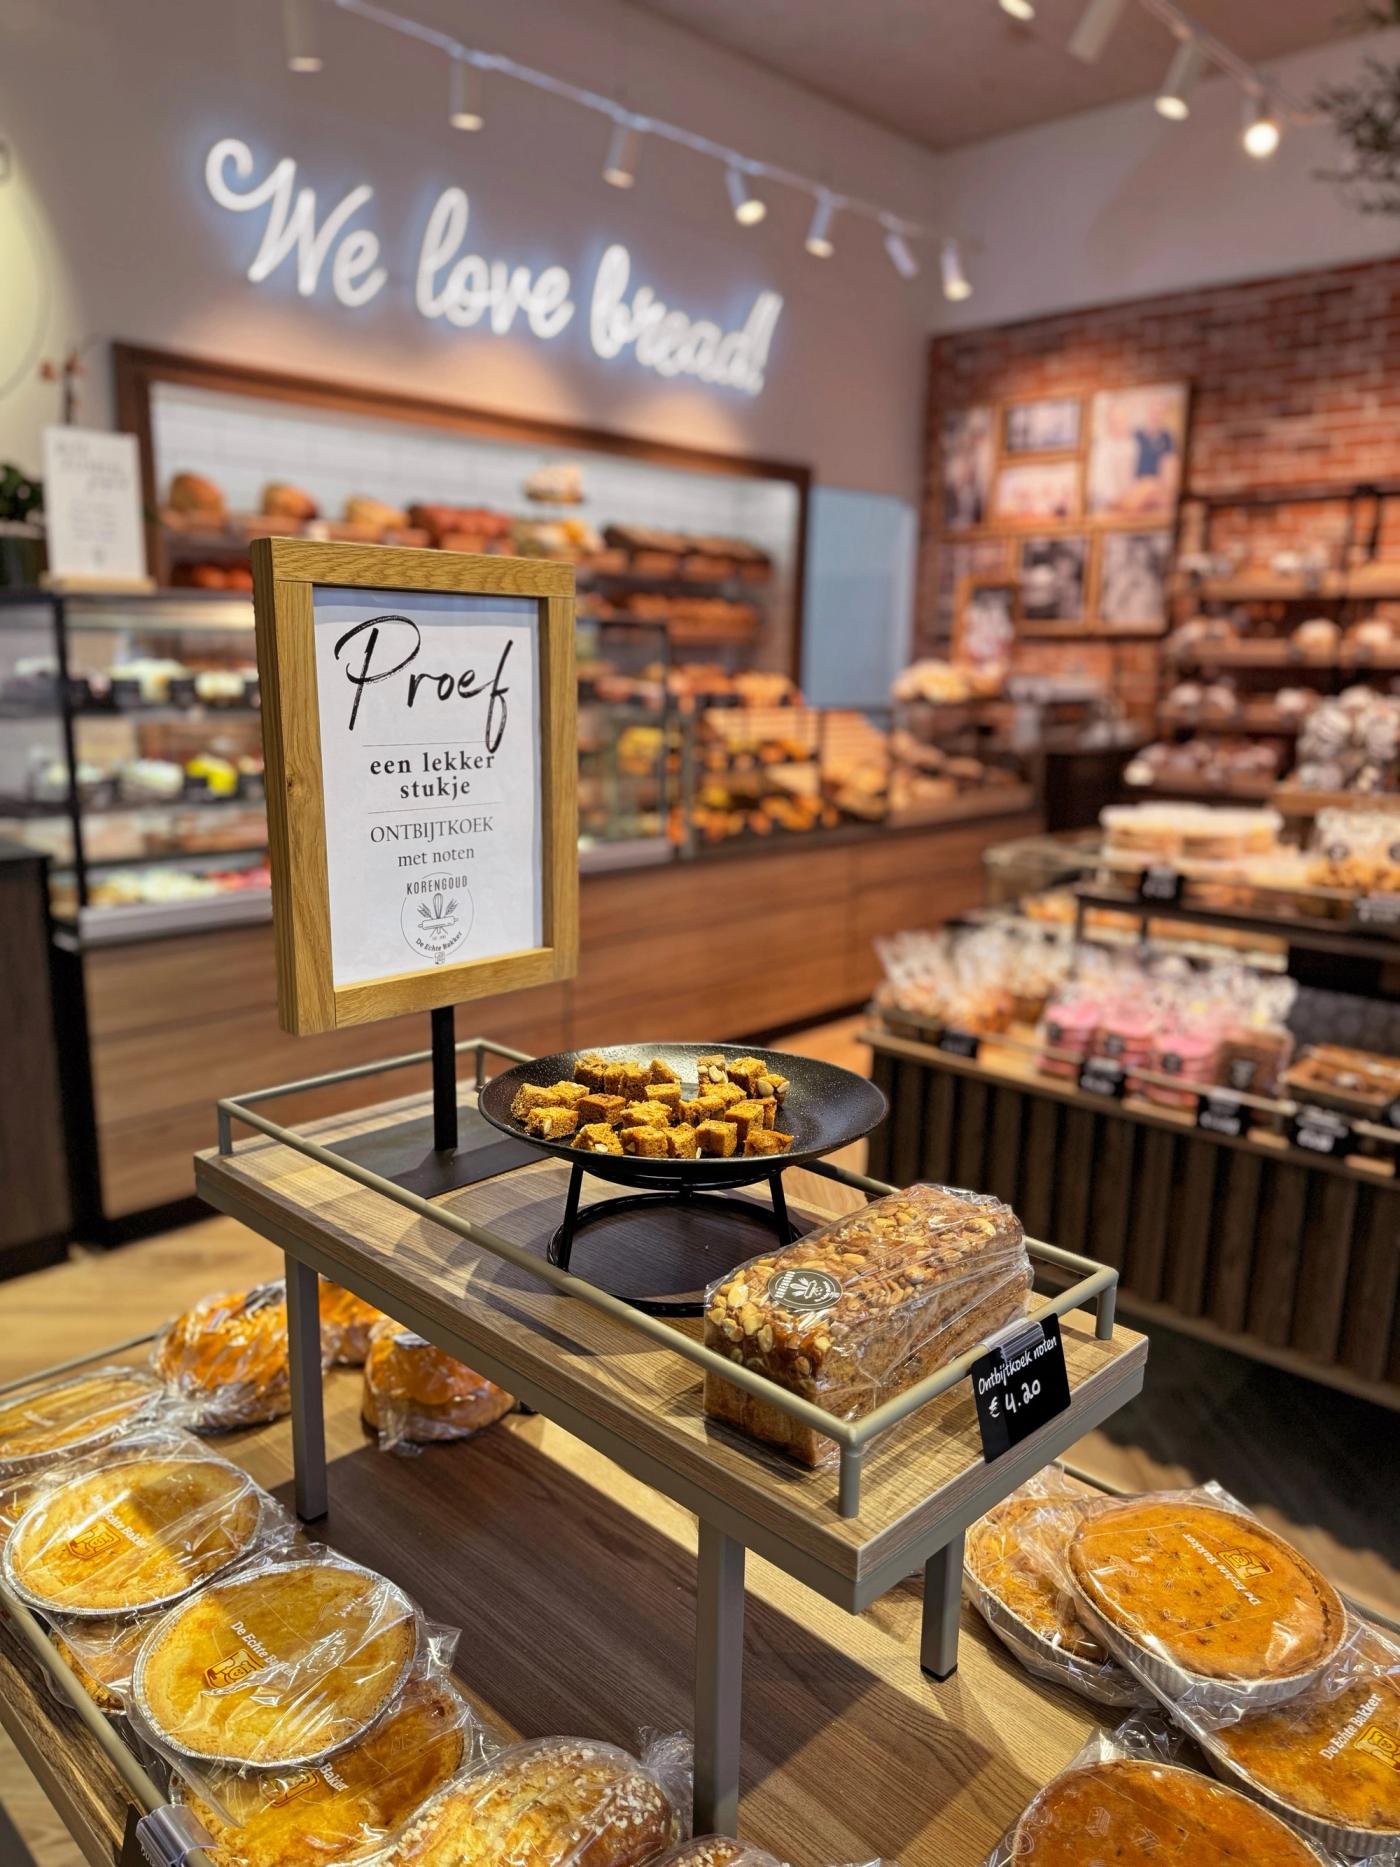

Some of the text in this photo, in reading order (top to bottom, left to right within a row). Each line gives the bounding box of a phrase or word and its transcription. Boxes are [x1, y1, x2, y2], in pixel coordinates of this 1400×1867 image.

[206, 138, 387, 307] We
[416, 187, 575, 339] love
[334, 615, 513, 754] Proef
[370, 750, 495, 775] een lekker
[400, 775, 470, 800] stukje
[370, 816, 494, 843] ONTBIJTKOEK
[397, 847, 475, 868] met noten
[406, 875, 468, 895] KORENGOUD
[978, 1336, 1057, 1395] Ontbijtkoek noten
[988, 1379, 1041, 1418] € 4.20
[230, 1620, 246, 1636] De
[242, 1631, 267, 1658] Echte
[1318, 1693, 1384, 1760] De Echte Bakker
